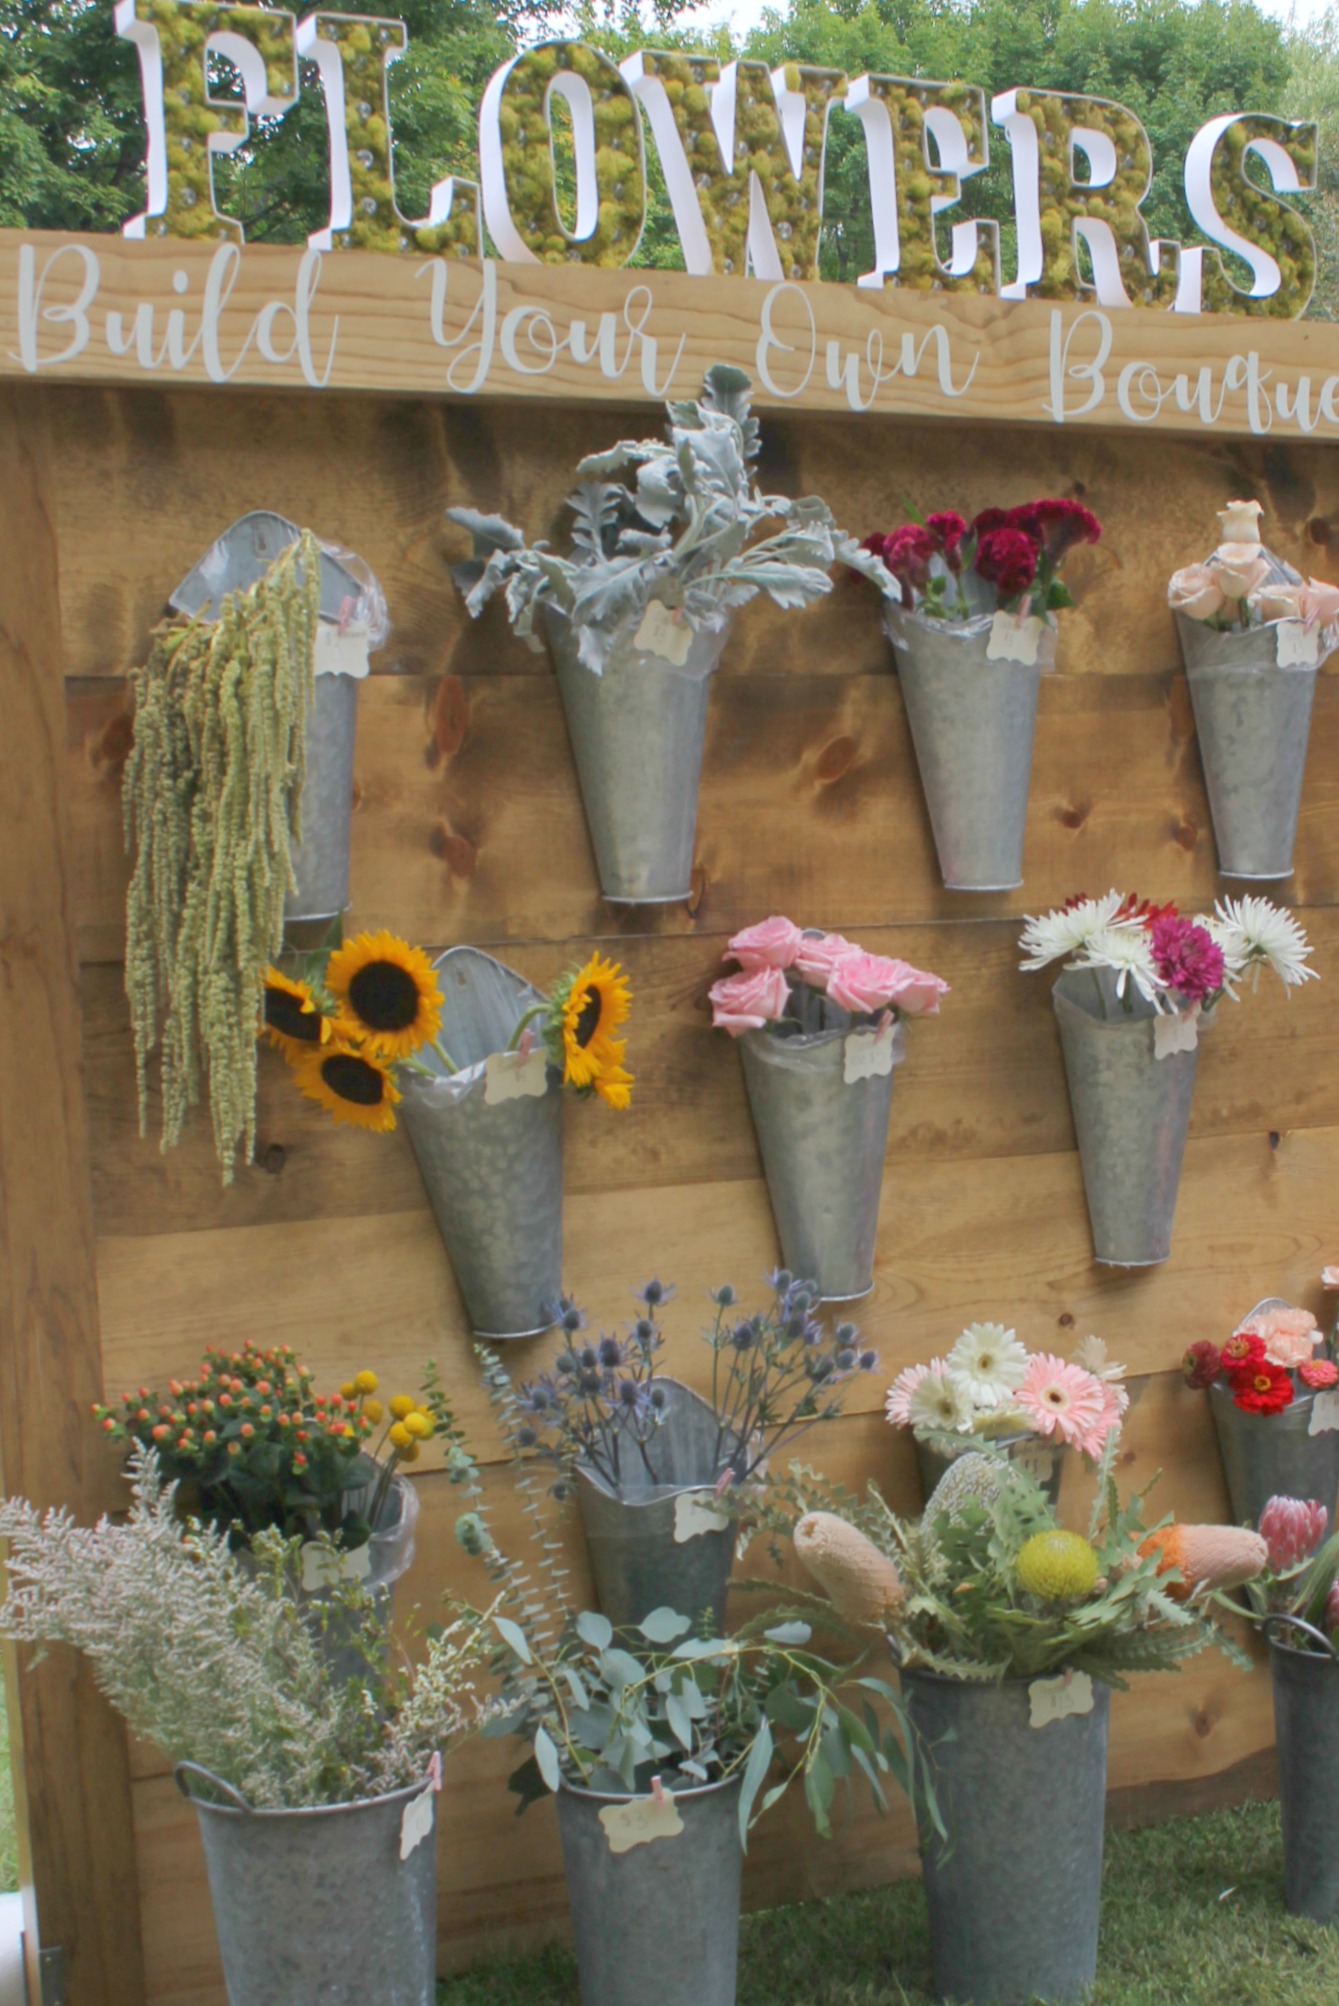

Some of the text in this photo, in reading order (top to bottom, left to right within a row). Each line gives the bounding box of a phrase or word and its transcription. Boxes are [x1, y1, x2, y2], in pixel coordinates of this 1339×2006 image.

[114, 0, 1318, 321] FLOWERS
[8, 243, 338, 387] Build
[415, 257, 686, 396] Your
[756, 283, 980, 412] Own
